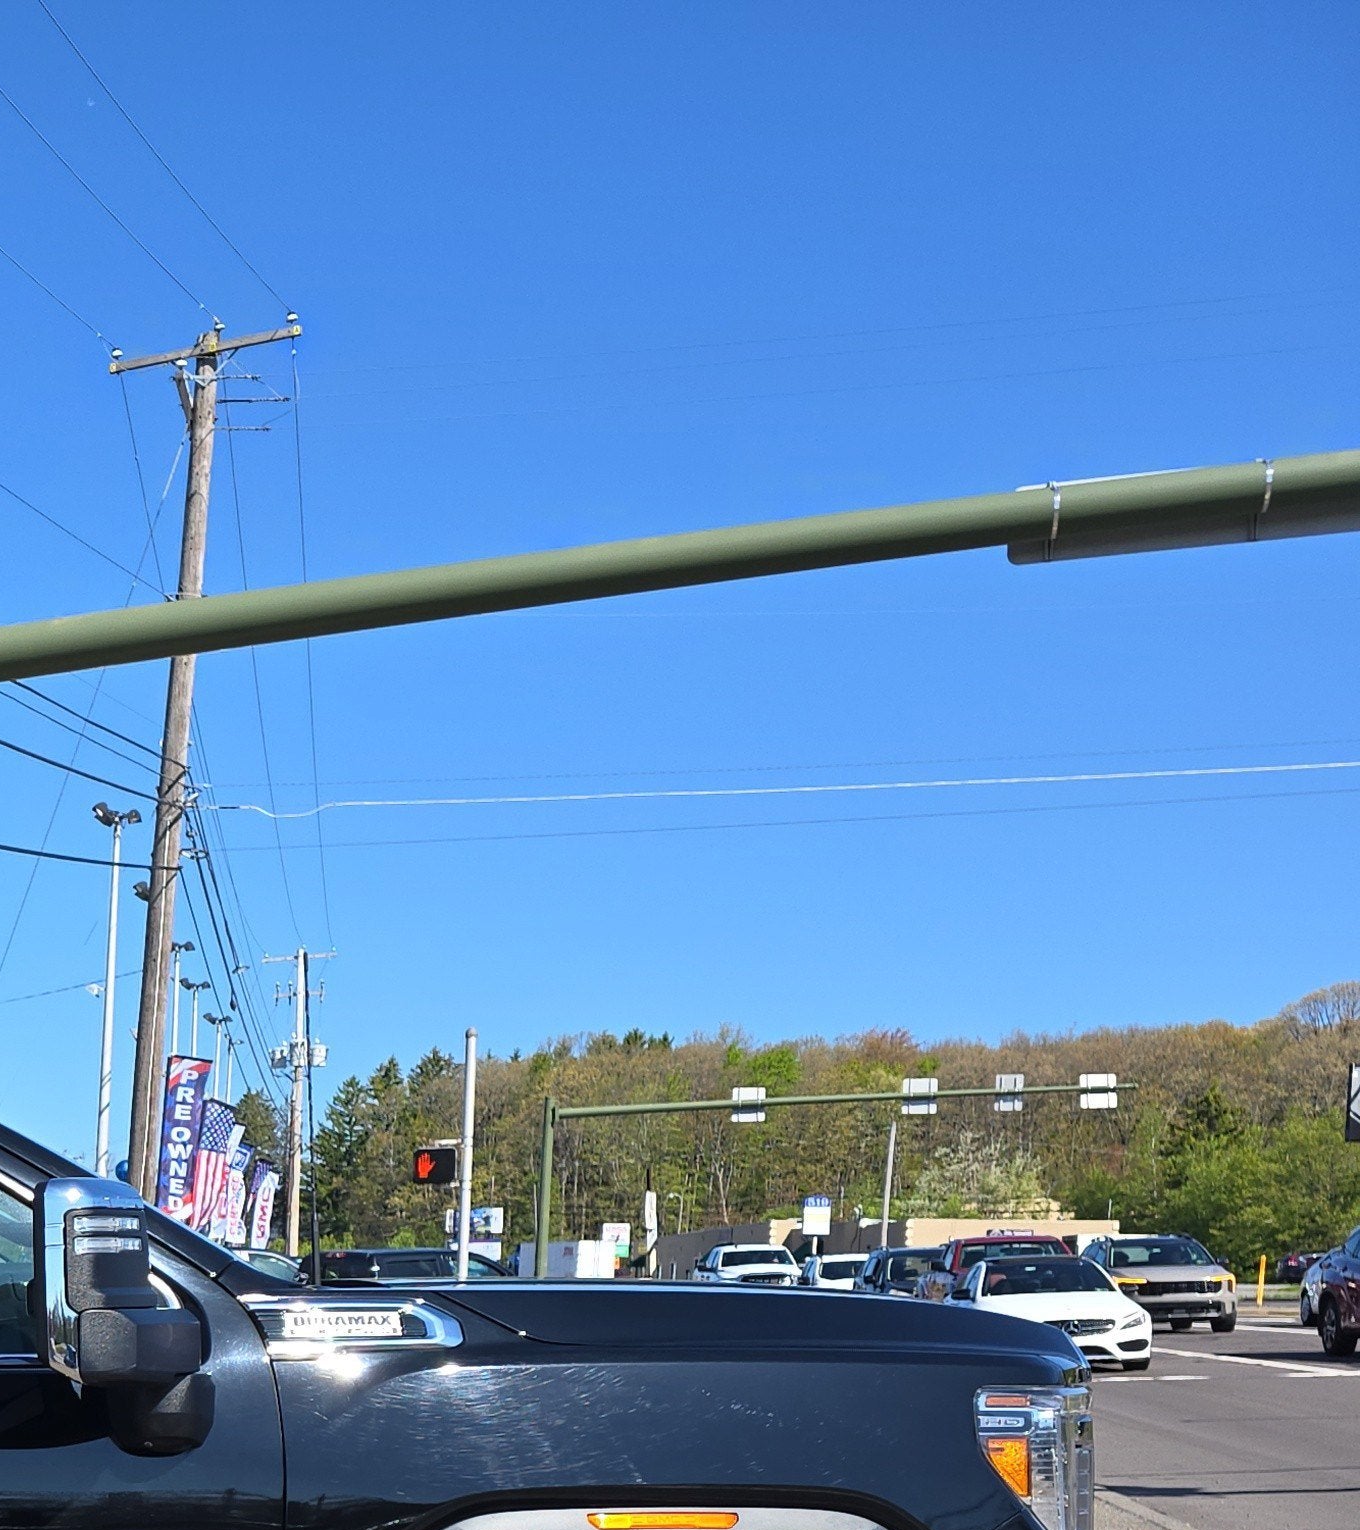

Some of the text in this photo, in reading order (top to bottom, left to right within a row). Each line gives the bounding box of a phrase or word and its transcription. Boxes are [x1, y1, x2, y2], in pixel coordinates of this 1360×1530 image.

[167, 1069, 199, 1209] PRE OWNED
[255, 1186, 271, 1239] GMC
